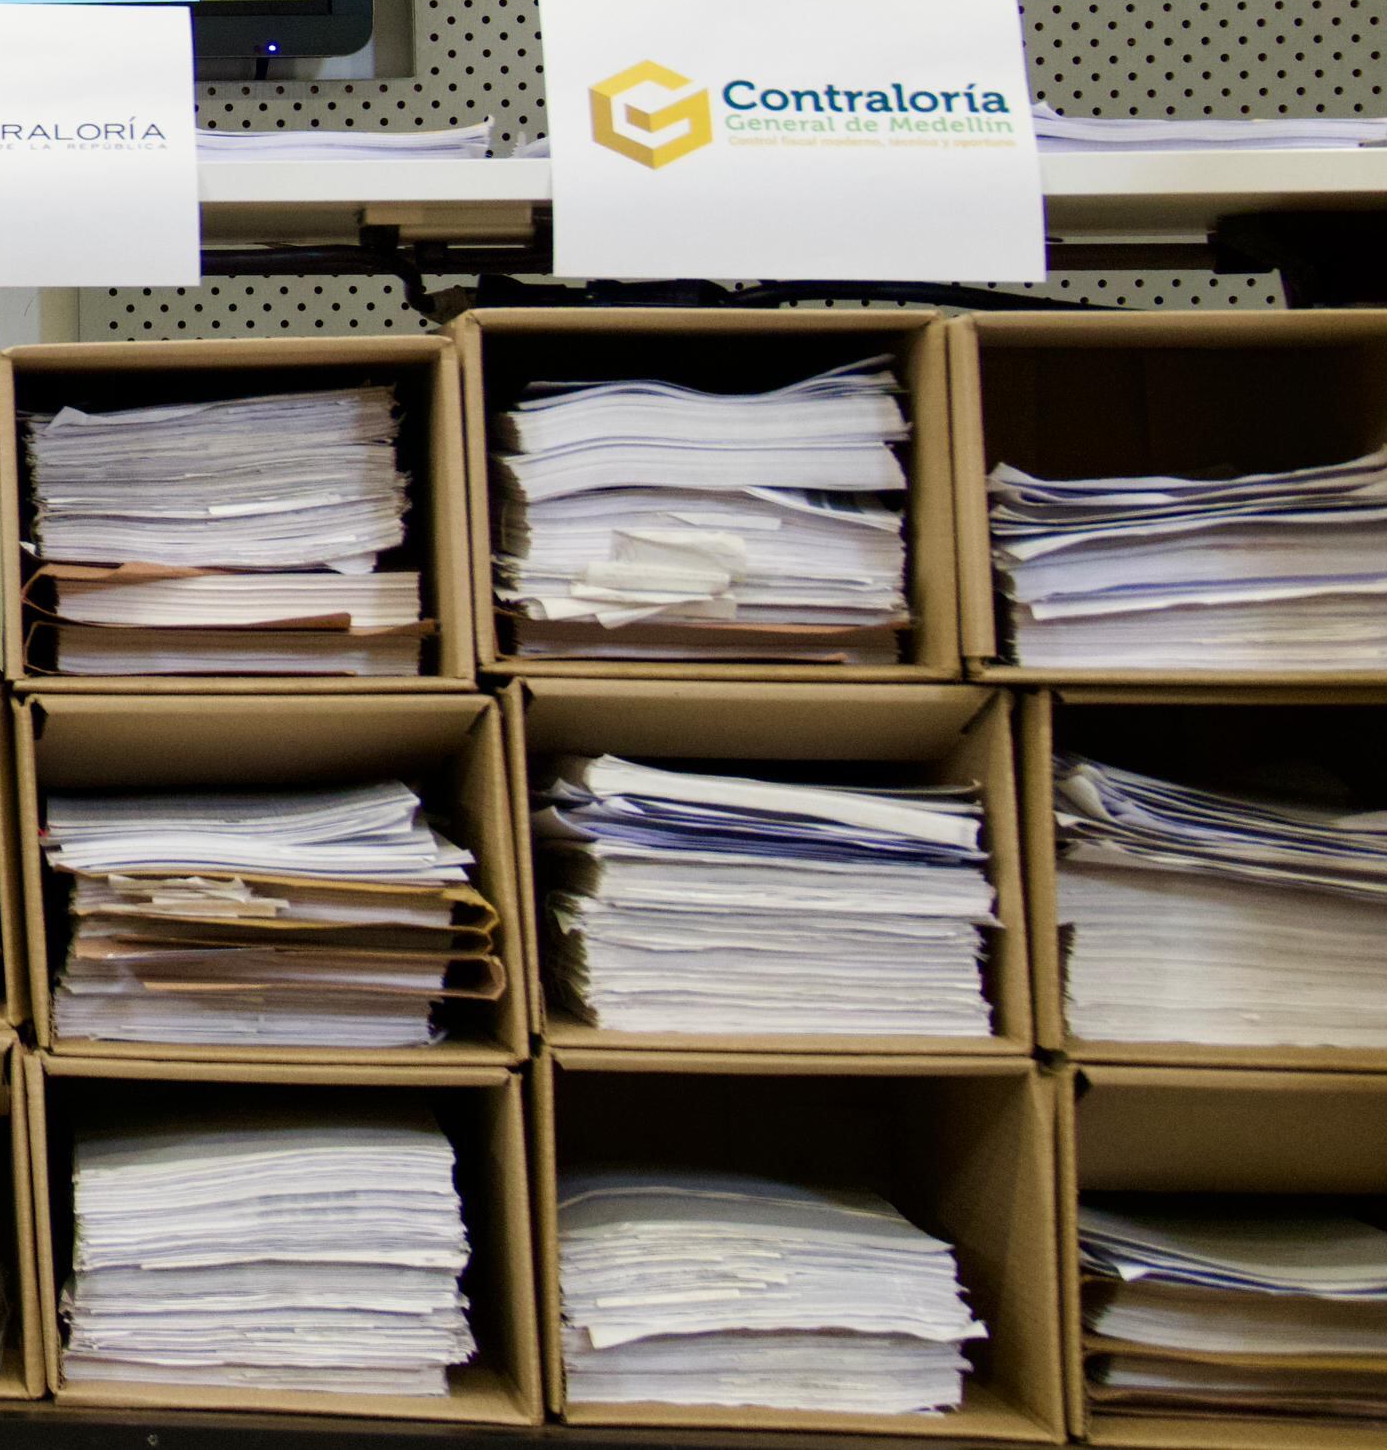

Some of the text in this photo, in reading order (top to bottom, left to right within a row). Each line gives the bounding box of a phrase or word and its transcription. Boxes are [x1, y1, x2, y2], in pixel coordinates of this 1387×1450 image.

[722, 80, 1010, 114] Contraloría
[725, 115, 1014, 133] General de Medellín
[30, 143, 51, 151] LA
